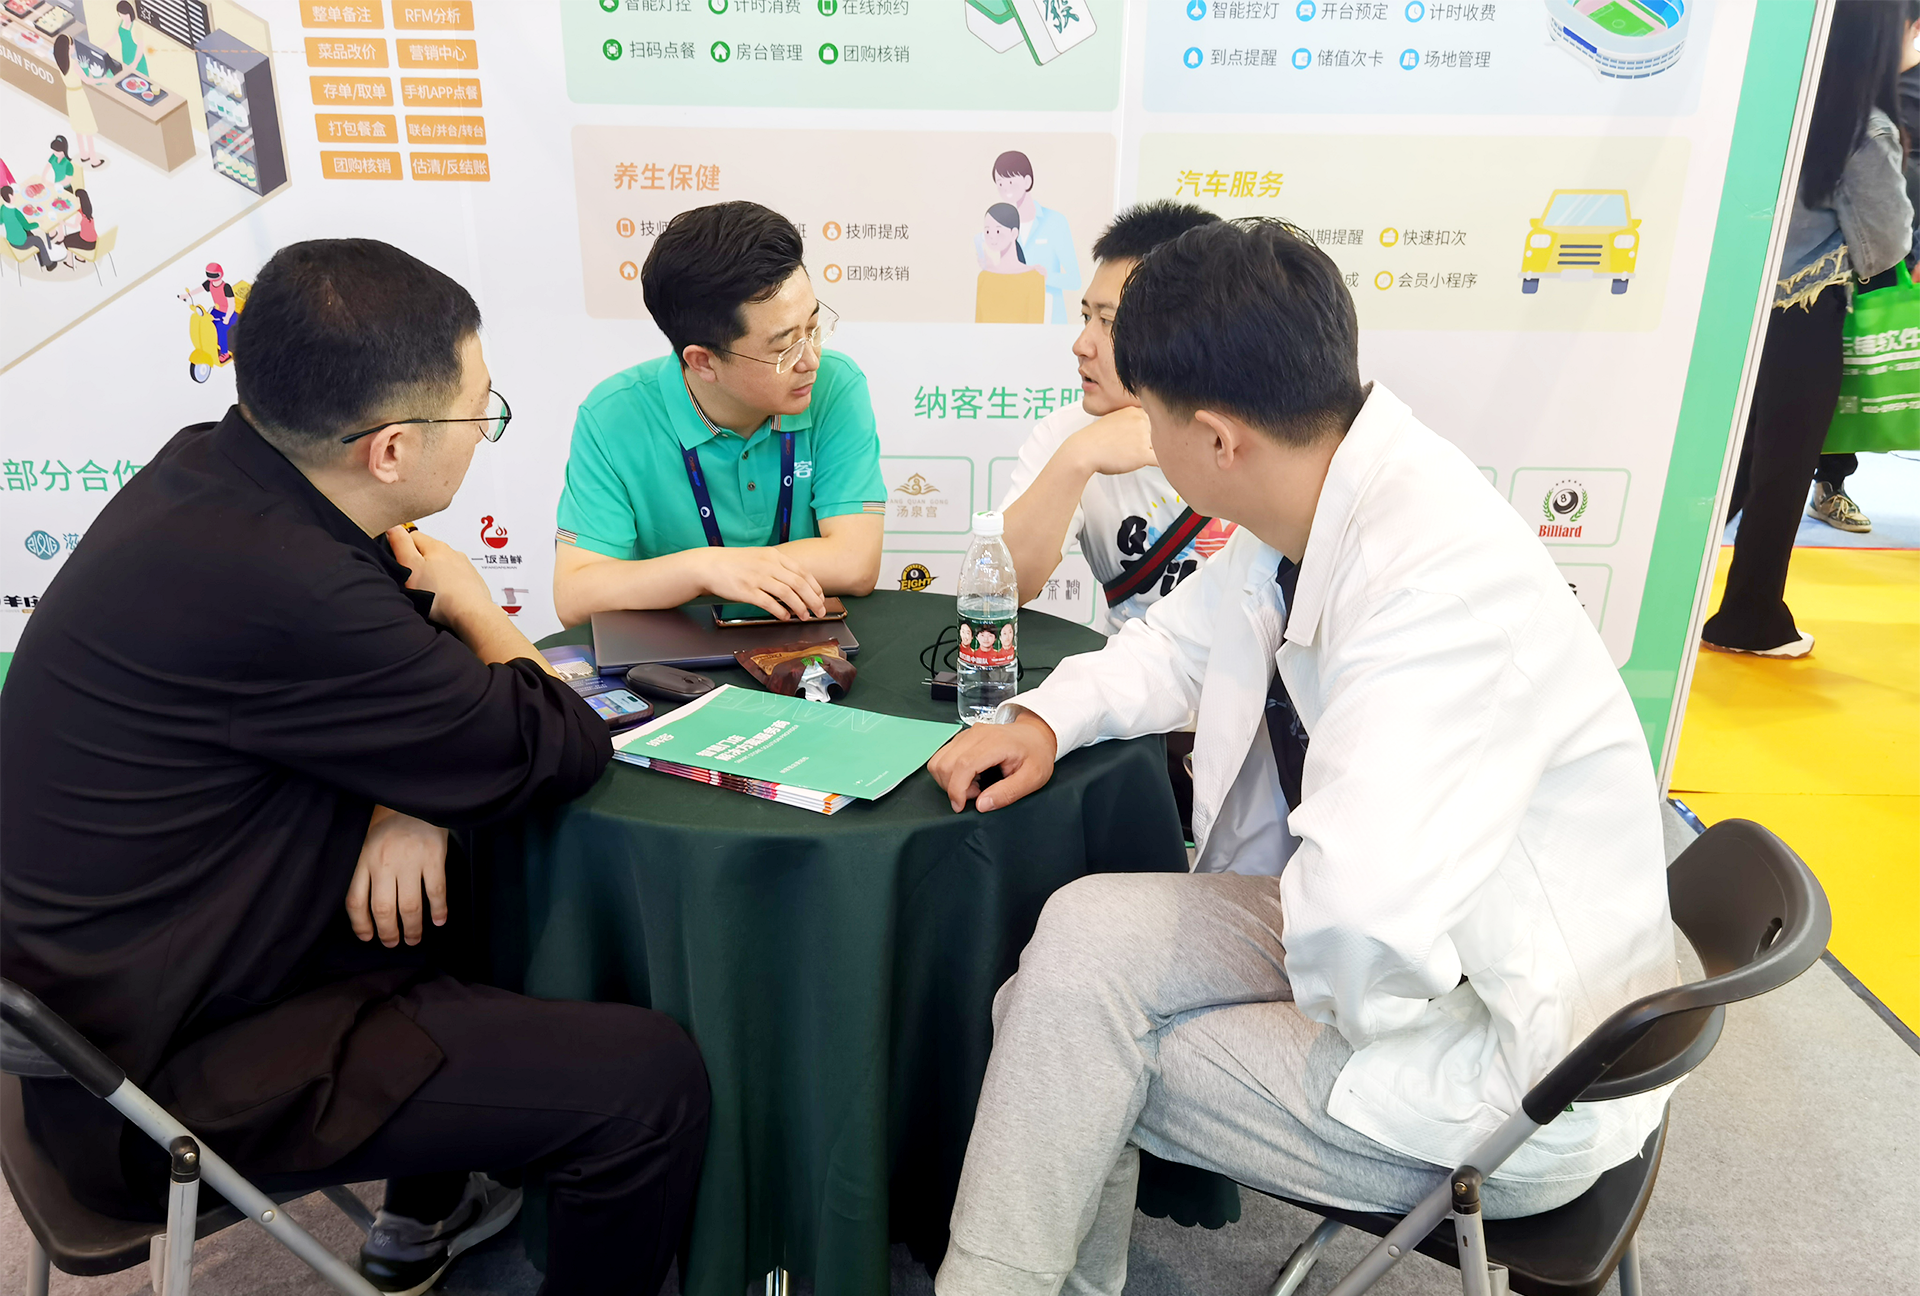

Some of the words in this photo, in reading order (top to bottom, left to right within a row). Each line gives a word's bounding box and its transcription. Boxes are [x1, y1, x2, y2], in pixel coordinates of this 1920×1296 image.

[312, 6, 373, 23] 整单备注
[405, 8, 461, 24] RFM分析
[842, 0, 909, 16] 在线预约
[1212, 2, 1280, 20] 智能控灯
[1321, 2, 1389, 21] 开台预定
[1429, 3, 1497, 22] 计时收费
[318, 43, 376, 60] 菜品改价
[409, 45, 467, 61] 营销中心
[629, 40, 696, 60] 扫码点餐
[736, 43, 803, 62] 房台管理
[843, 45, 910, 63] 团购核销
[1210, 49, 1278, 67] 到点提醒
[1317, 49, 1384, 68] 储值次卡
[1424, 50, 1491, 69] 场地管理
[23, 58, 55, 84] FOOD
[323, 83, 387, 100] 存单/取单
[404, 85, 478, 100] 手机APP点餐
[328, 120, 387, 137] 打包餐盒
[408, 124, 484, 138] 联台/并台/转台
[333, 157, 392, 174] 团购核销
[412, 159, 488, 175] 估清/反结账
[613, 162, 721, 191] 养生保健
[1175, 169, 1284, 198] 汽车服务
[846, 223, 910, 240] 技师提成
[1402, 229, 1467, 247] 快速扣次
[846, 265, 910, 282] 团购核销
[1398, 272, 1478, 289] 会员小程序
[896, 505, 938, 518] 汤泉宫
[1538, 525, 1582, 538] Billiard
[901, 578, 932, 590] EIGHT
